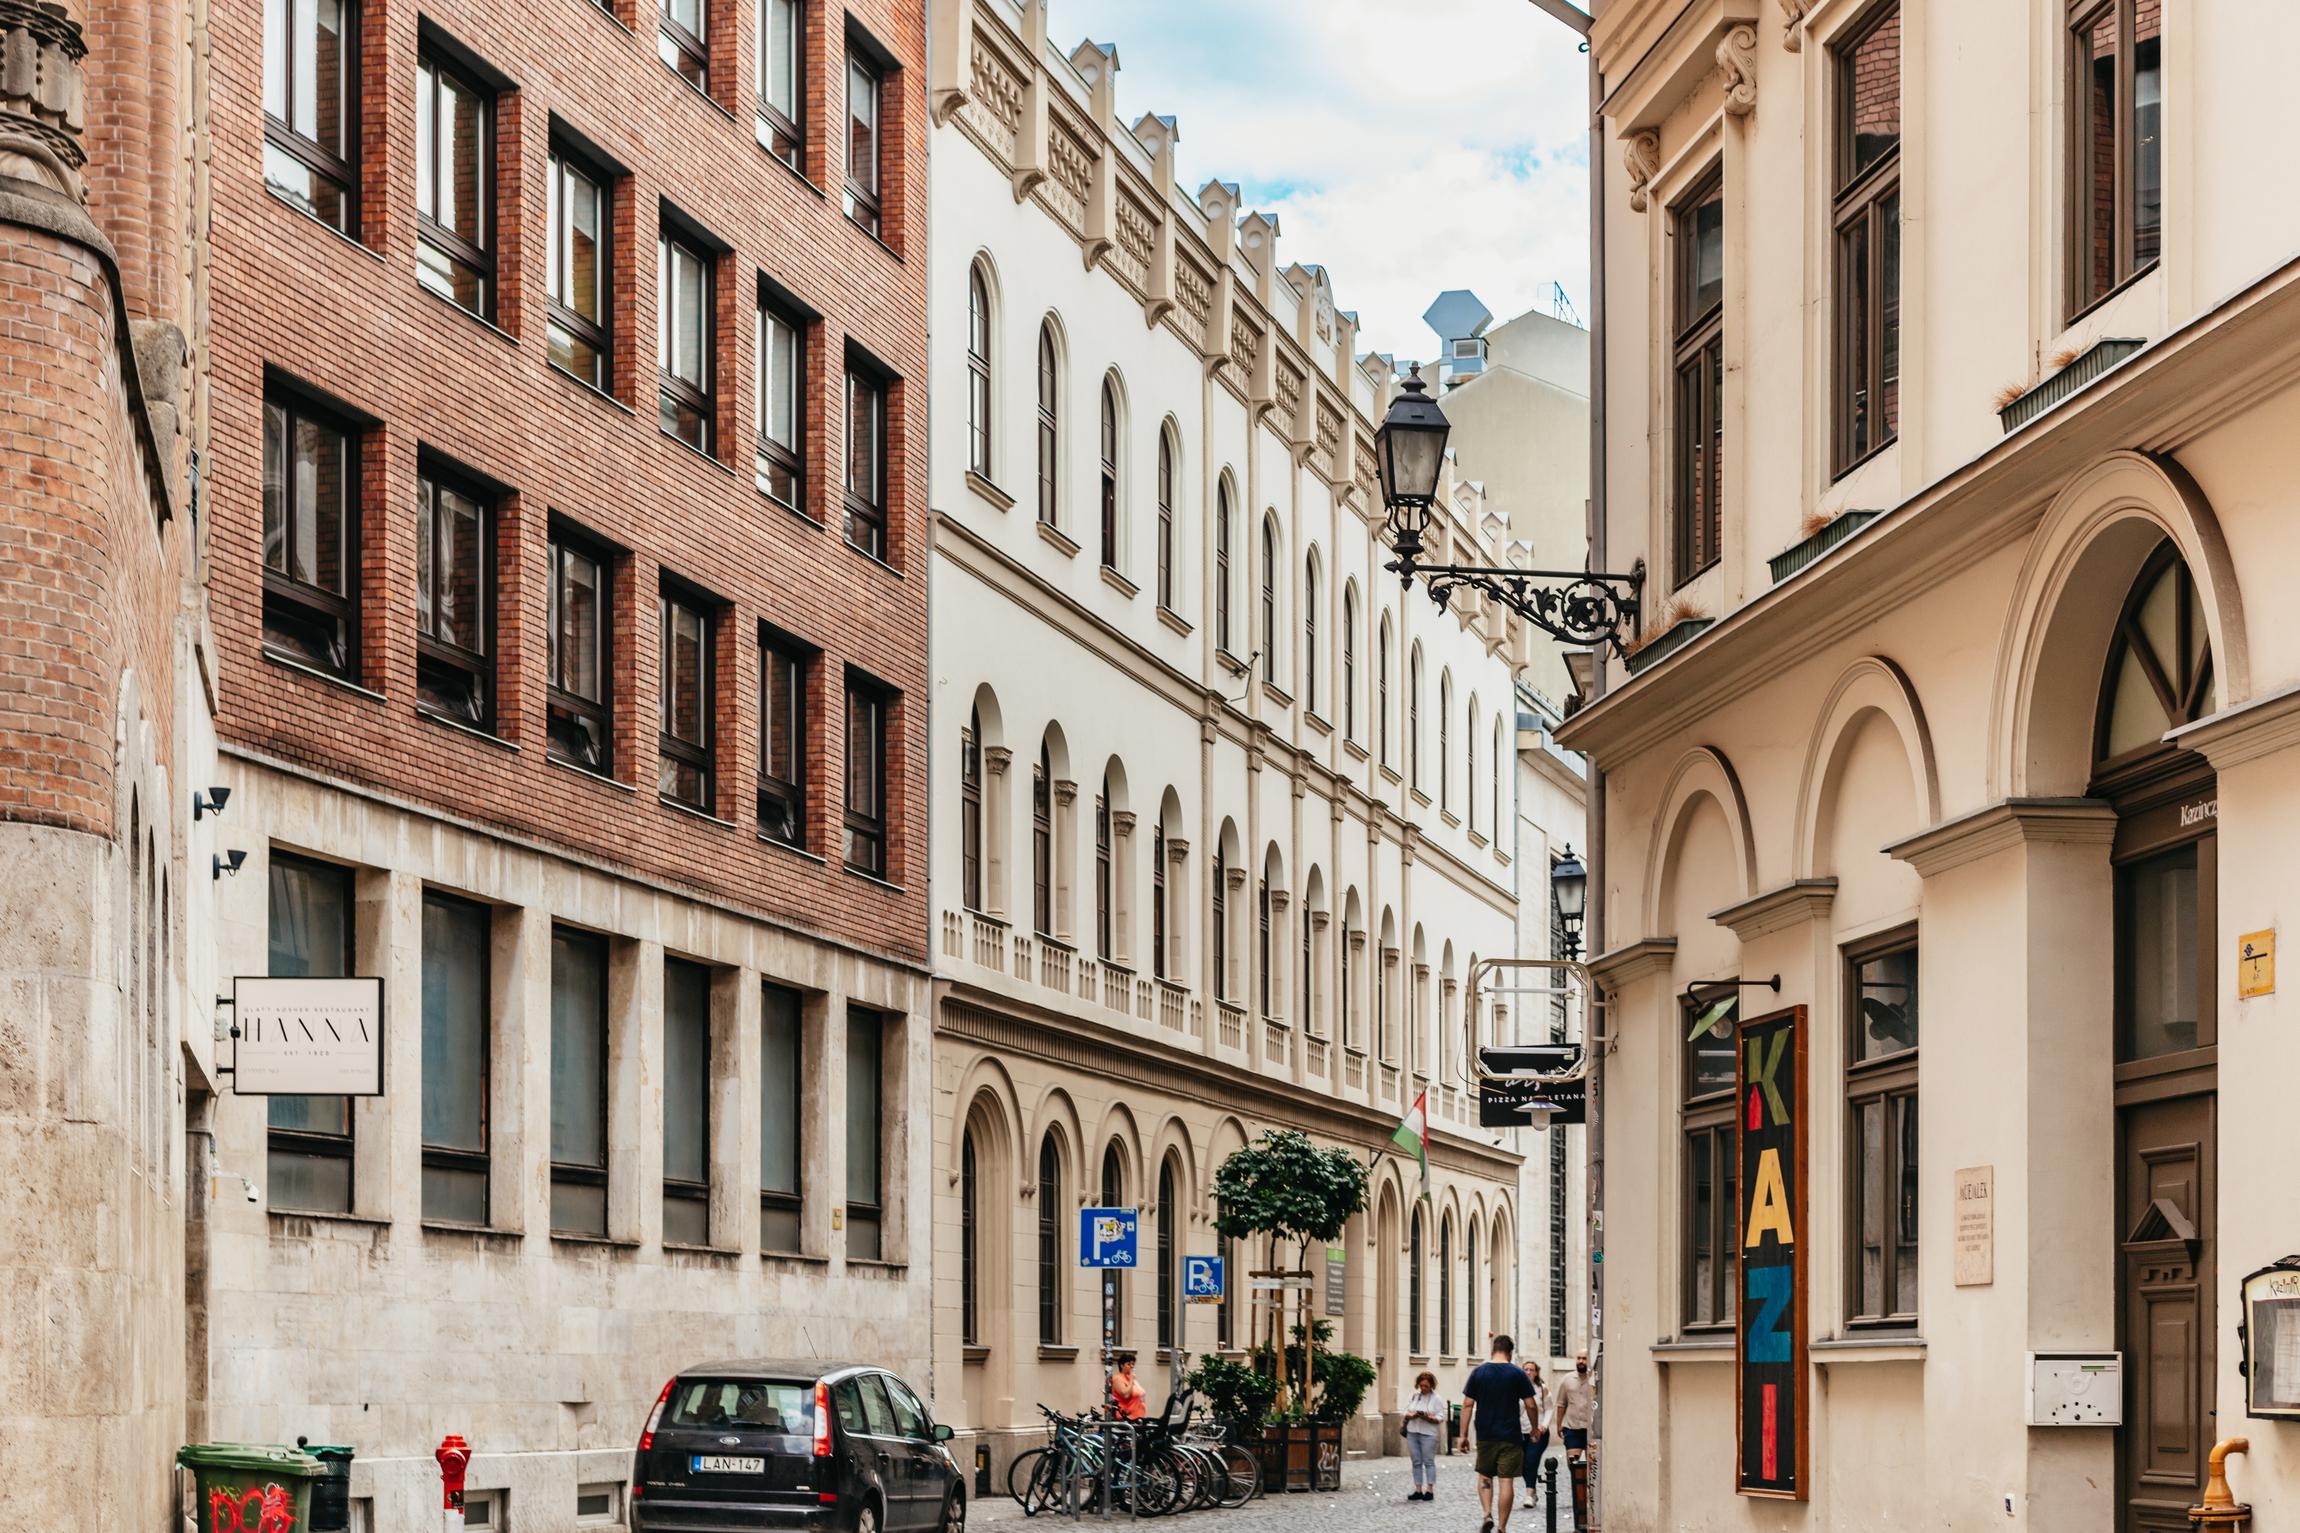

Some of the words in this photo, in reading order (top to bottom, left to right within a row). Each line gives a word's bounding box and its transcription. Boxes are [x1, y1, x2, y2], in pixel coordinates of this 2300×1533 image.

[2180, 800, 2218, 827] Kazincz
[244, 1017, 369, 1043] HANNA
[1487, 1096, 1517, 1104] PIZZA
[1521, 1093, 1586, 1102] NALETANA
[1745, 1027, 1794, 1482] KAZI
[703, 1457, 761, 1471] LAN-147
